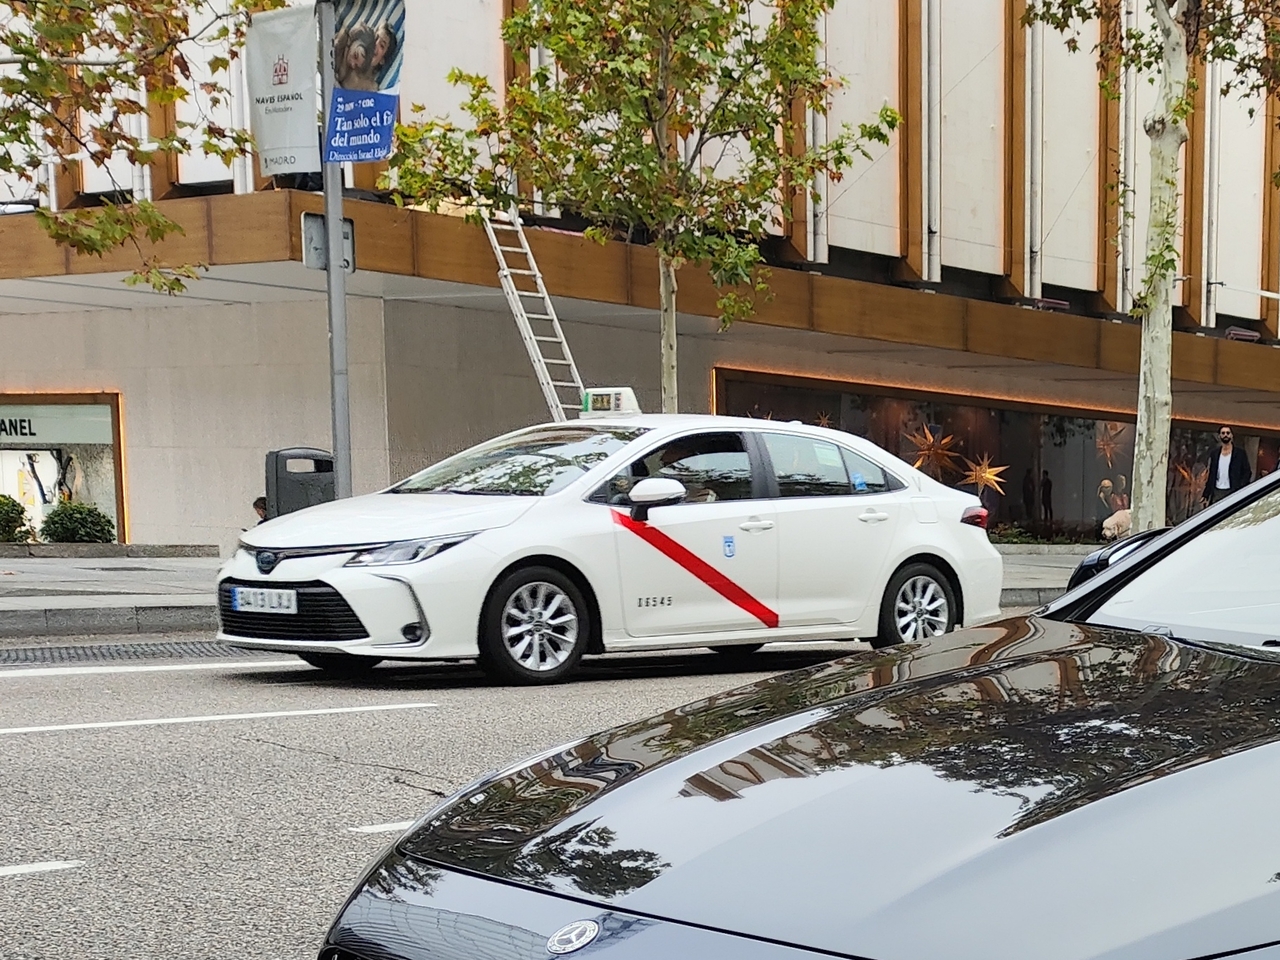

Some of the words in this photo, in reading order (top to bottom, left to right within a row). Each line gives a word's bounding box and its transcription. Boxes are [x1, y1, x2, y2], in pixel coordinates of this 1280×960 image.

[255, 96, 275, 105] NAVES
[335, 117, 352, 131] Tan
[353, 113, 369, 129] solo
[371, 111, 381, 127] el
[331, 132, 348, 147] del
[349, 129, 381, 147] mundo
